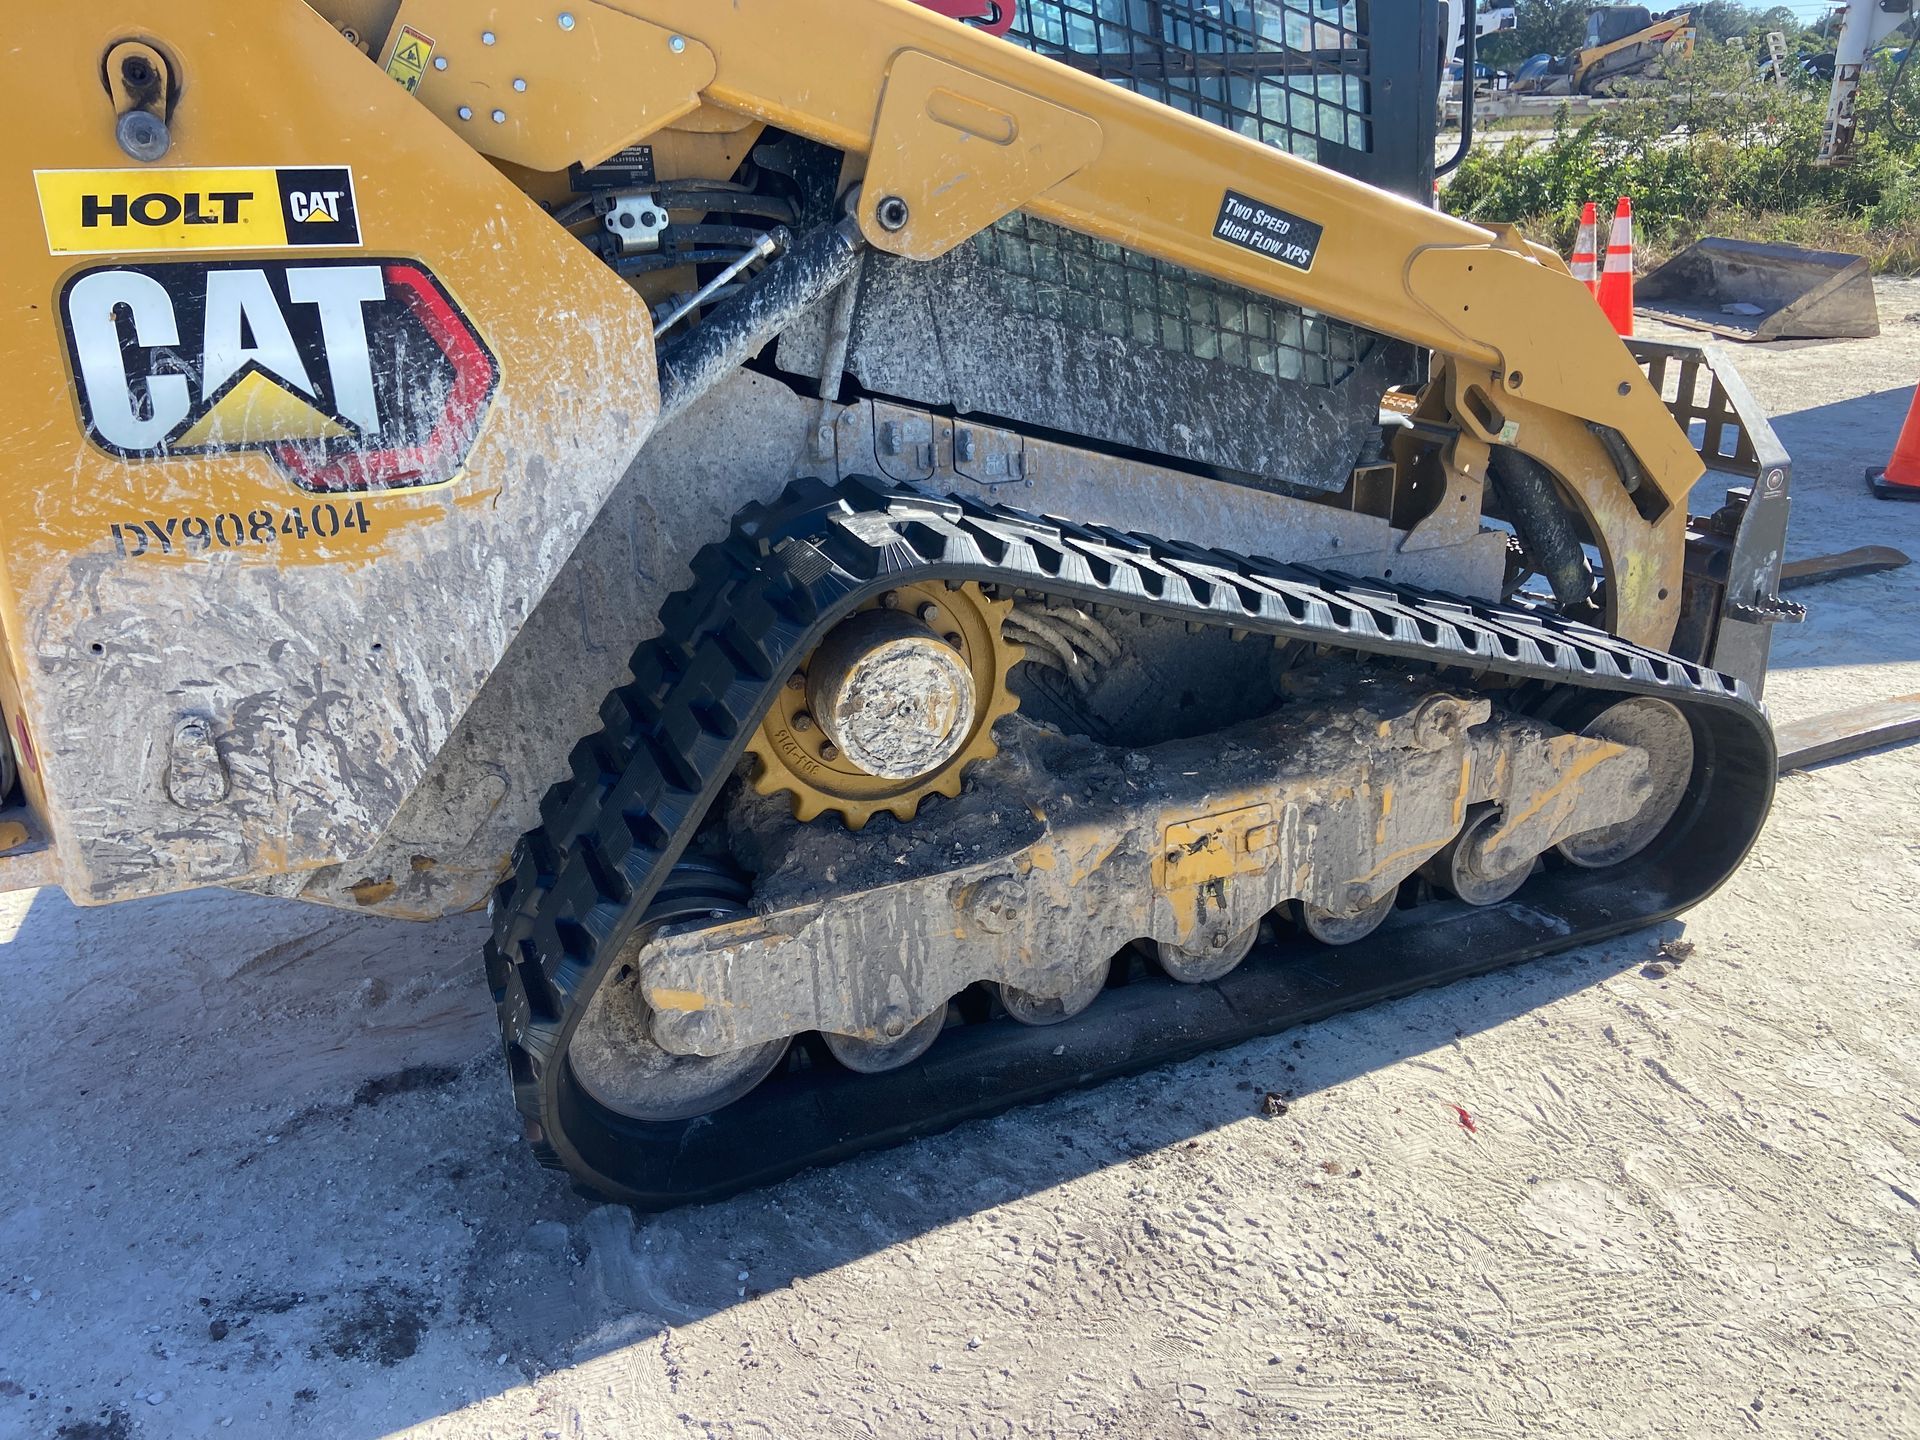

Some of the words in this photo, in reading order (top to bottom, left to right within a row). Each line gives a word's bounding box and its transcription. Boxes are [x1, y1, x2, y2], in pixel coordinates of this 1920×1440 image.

[82, 192, 254, 228] HOLT
[289, 191, 342, 223] CAT
[1225, 198, 1253, 221] TWO
[1252, 209, 1290, 235] SPEED
[1218, 219, 1251, 243] HIGH
[1249, 230, 1283, 255] FLOW
[1281, 243, 1311, 265] XPS
[68, 265, 386, 450] CAT
[110, 501, 371, 560] DY908404
